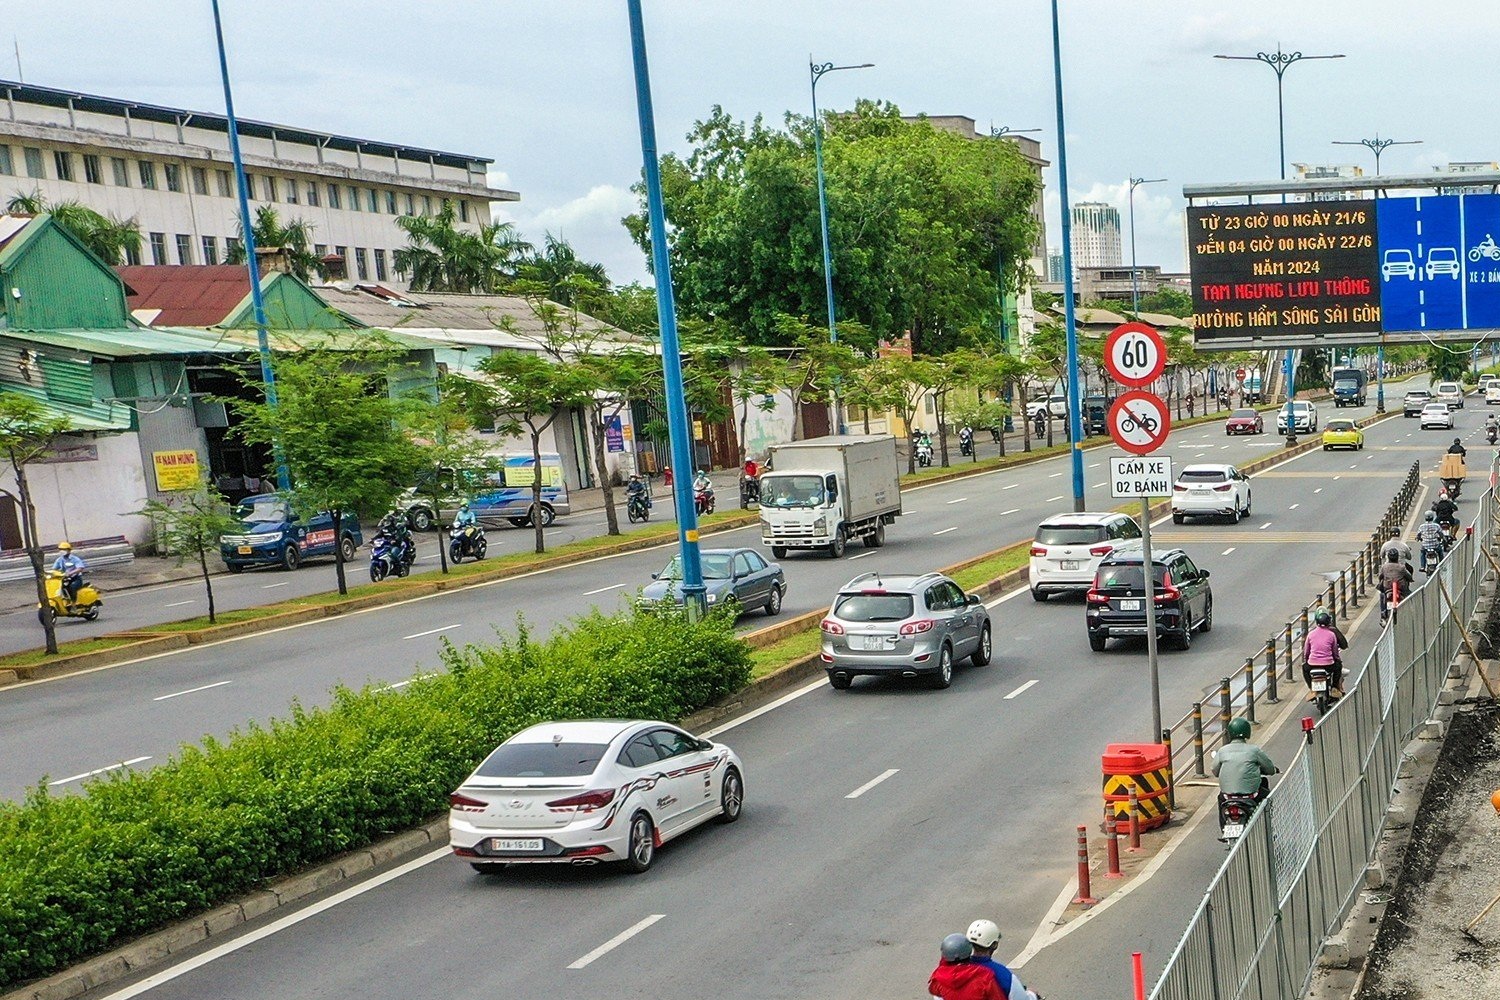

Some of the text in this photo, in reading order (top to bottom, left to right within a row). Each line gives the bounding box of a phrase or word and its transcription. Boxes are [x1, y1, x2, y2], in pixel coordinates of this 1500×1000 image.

[1199, 209, 1366, 231] TỪ 23 GIỜ 00 NGÀY 21/6
[1228, 240, 1246, 254] 04
[1249, 235, 1275, 252] GIỜ
[1278, 238, 1294, 251] 00
[1297, 232, 1336, 250] NGÀY
[1339, 234, 1372, 249] 22/6
[1253, 258, 1320, 276] NĂM 2024
[1469, 271, 1478, 283] XE
[1480, 271, 1485, 283] 2
[1201, 276, 1371, 303] TẠM NGƯNG LƯU THÔNG
[1248, 304, 1278, 327] HẦM
[1282, 305, 1319, 326] SÔNG
[1352, 303, 1380, 323] GÒN
[1122, 340, 1148, 369] 60
[162, 454, 177, 466] NAM
[1118, 459, 1164, 475] CẤM XE
[1116, 477, 1168, 493] 02 BÁNH
